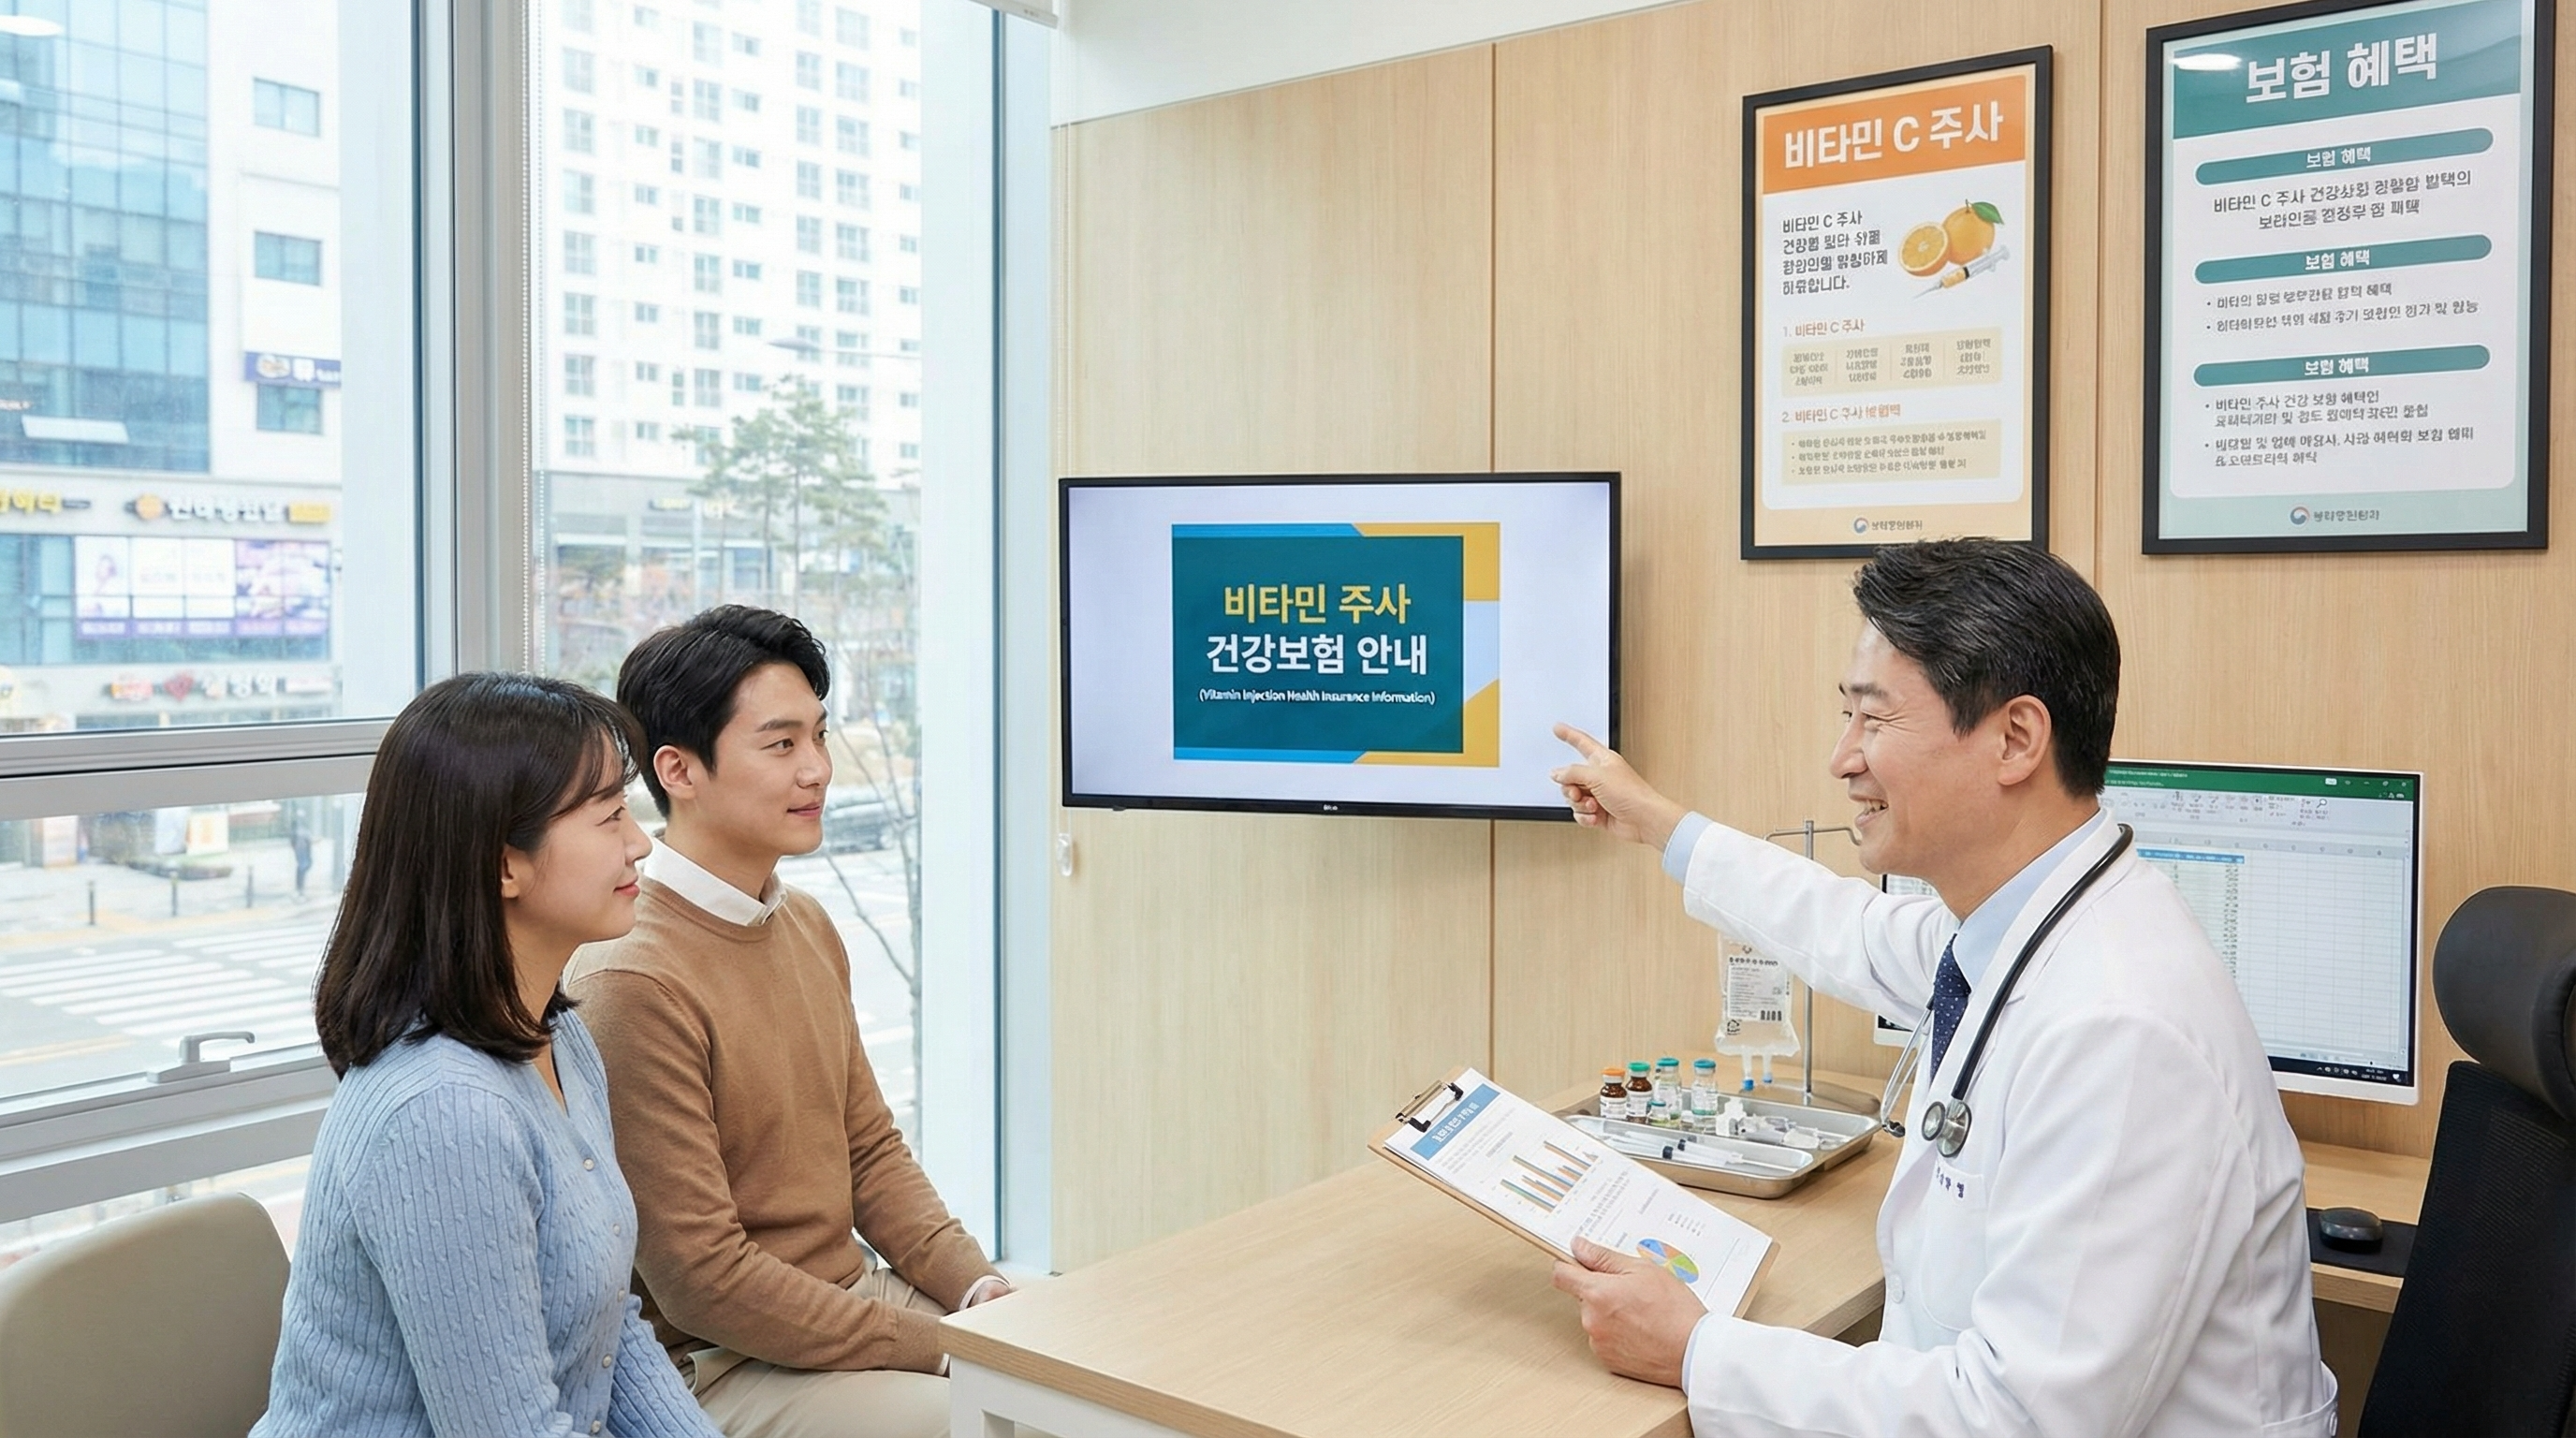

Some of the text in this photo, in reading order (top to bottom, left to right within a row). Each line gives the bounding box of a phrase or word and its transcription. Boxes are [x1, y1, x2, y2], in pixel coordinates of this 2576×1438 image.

[2246, 33, 2437, 103] 보험 혜택
[1784, 100, 2003, 169] 비타민 C 주사
[2261, 194, 2272, 207] C
[2276, 189, 2305, 206] 주사
[1822, 214, 1833, 227] C
[1837, 210, 1863, 227] 주사
[1830, 321, 1839, 333] C
[1842, 318, 1865, 333] 주사
[2284, 393, 2308, 408] 건강
[1829, 408, 1839, 420] C
[1224, 583, 1412, 624] 비타민 주사
[1206, 633, 1427, 675] 건강보험 안내
